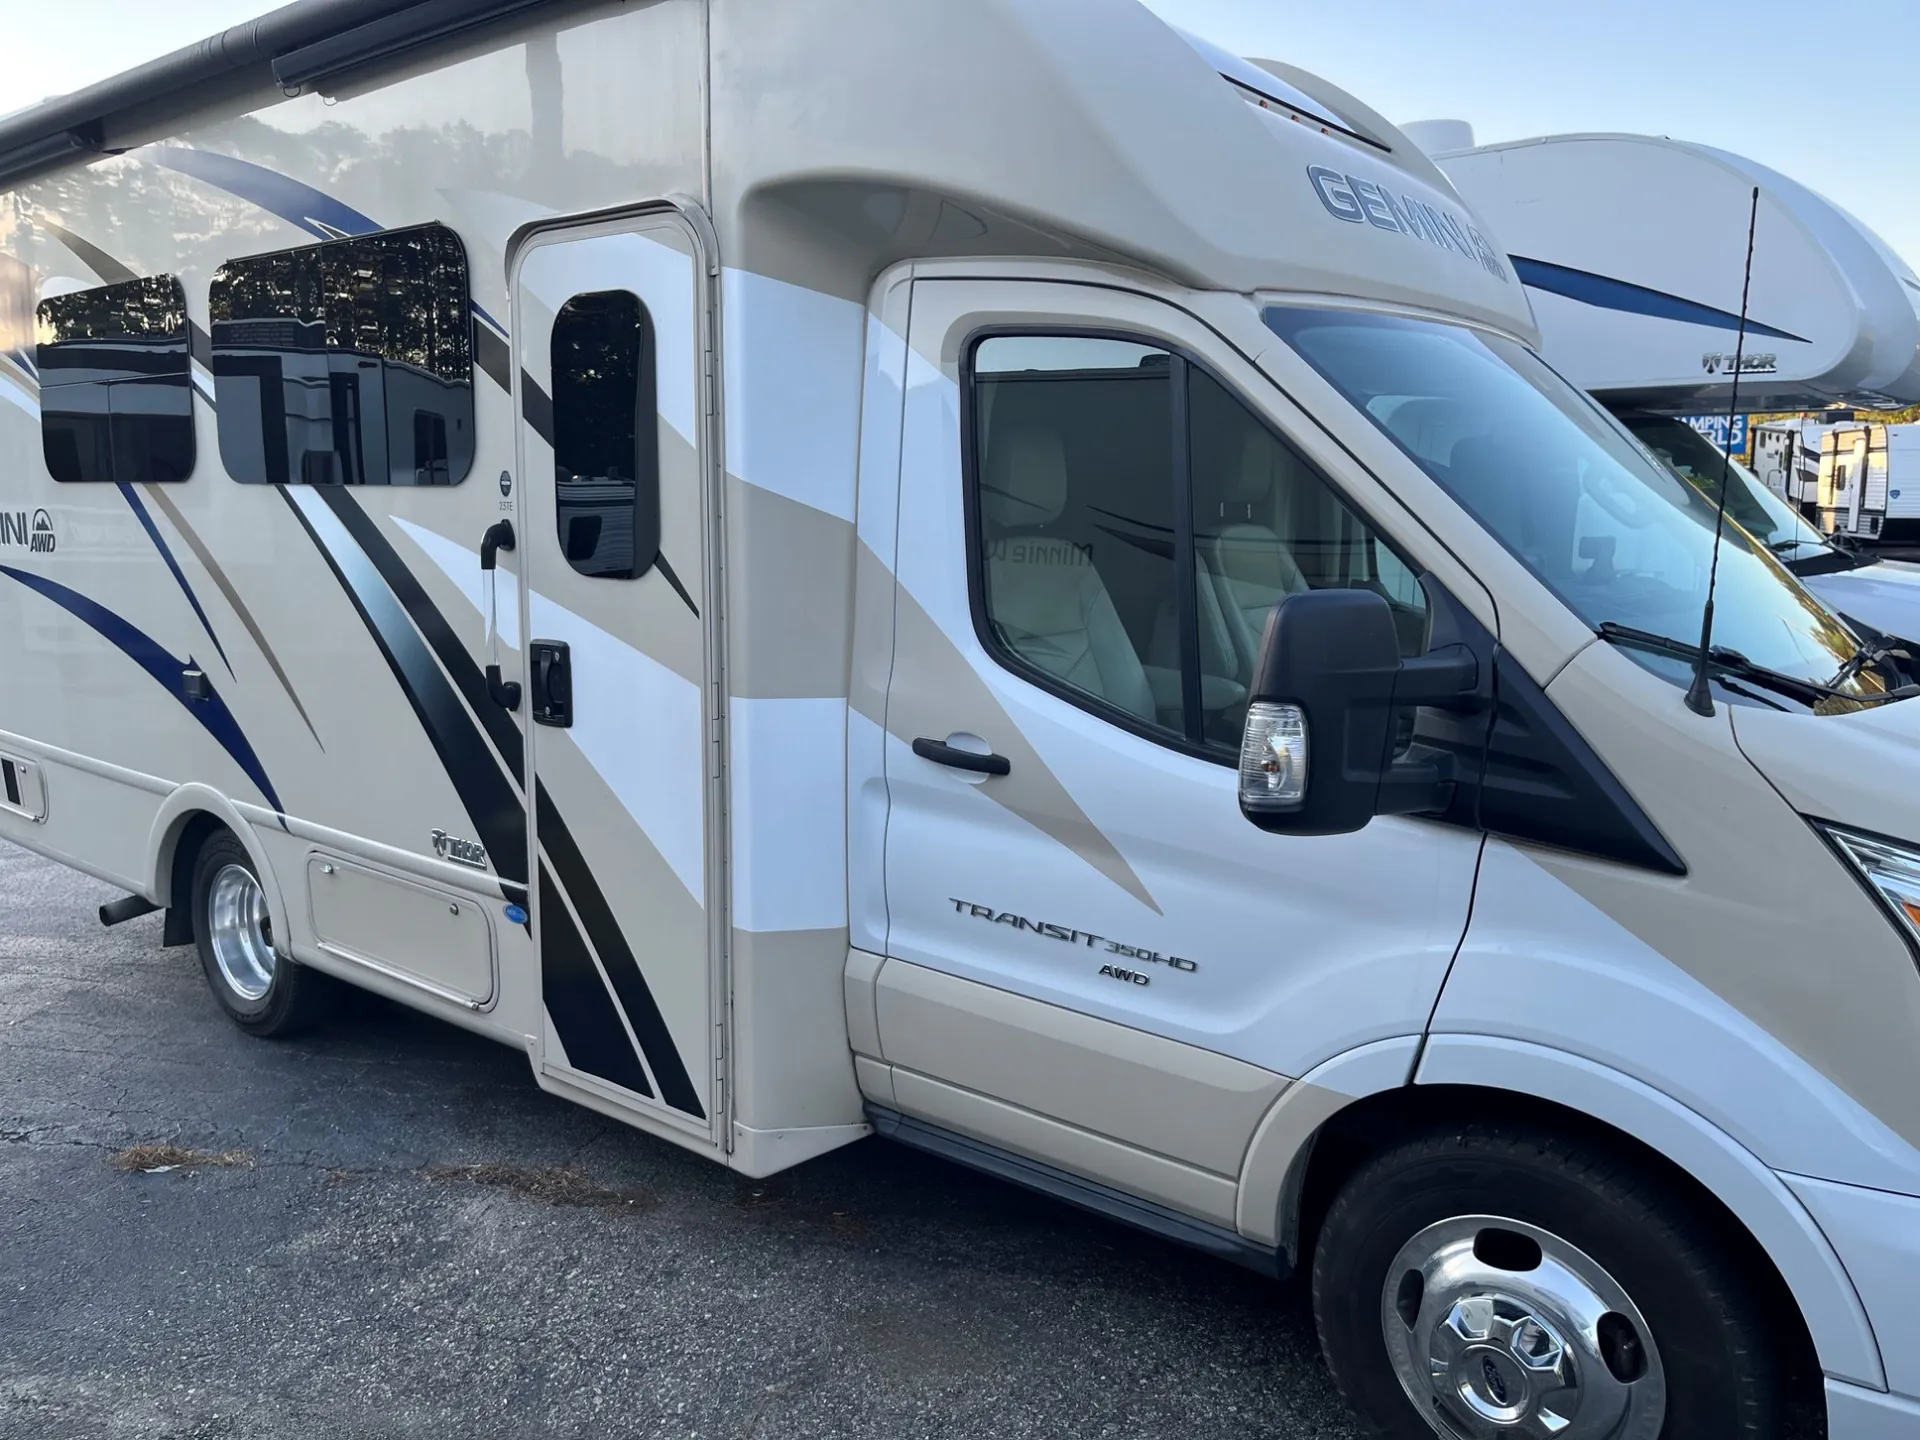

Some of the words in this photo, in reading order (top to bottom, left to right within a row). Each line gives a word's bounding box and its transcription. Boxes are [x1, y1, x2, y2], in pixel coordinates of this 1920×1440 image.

[1306, 164, 1480, 263] GEMINI
[1722, 354, 1777, 371] THOR
[1674, 415, 1744, 430] MPING
[1696, 429, 1743, 446] RLD
[30, 533, 56, 553] AWD
[447, 836, 486, 865] THOR
[949, 897, 1104, 948] TRANSIT
[1103, 940, 1199, 973] 350HD
[1099, 963, 1150, 986] AWD
